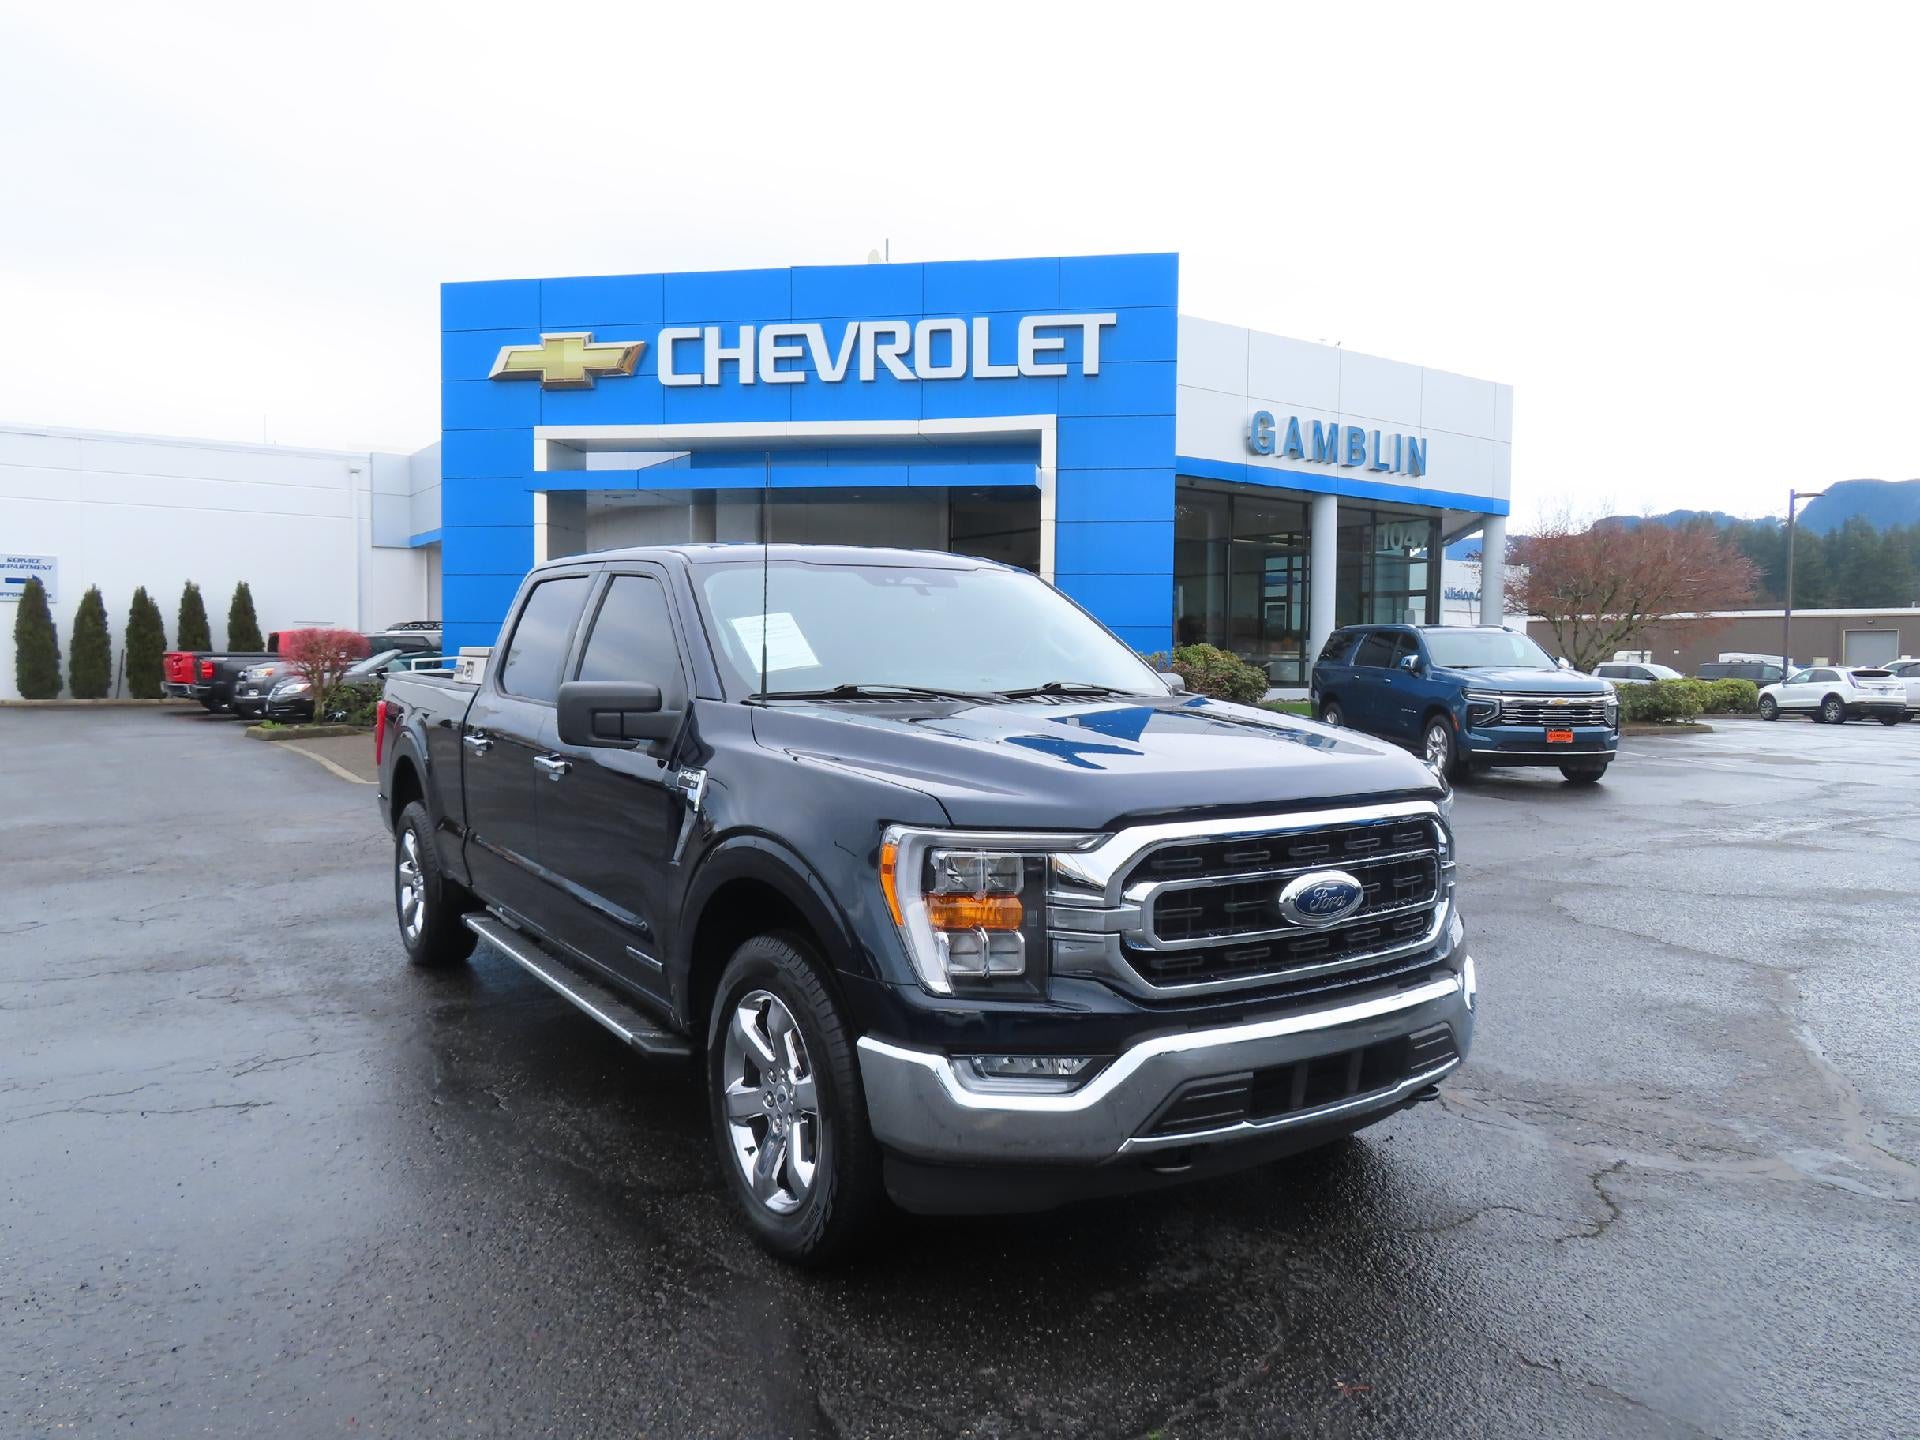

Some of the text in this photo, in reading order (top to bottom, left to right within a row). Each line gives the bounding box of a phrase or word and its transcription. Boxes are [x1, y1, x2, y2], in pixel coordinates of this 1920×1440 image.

[658, 313, 1117, 386] CHEVROLET
[1249, 410, 1427, 478] GAMBLIN
[1310, 886, 1348, 911] Ford
